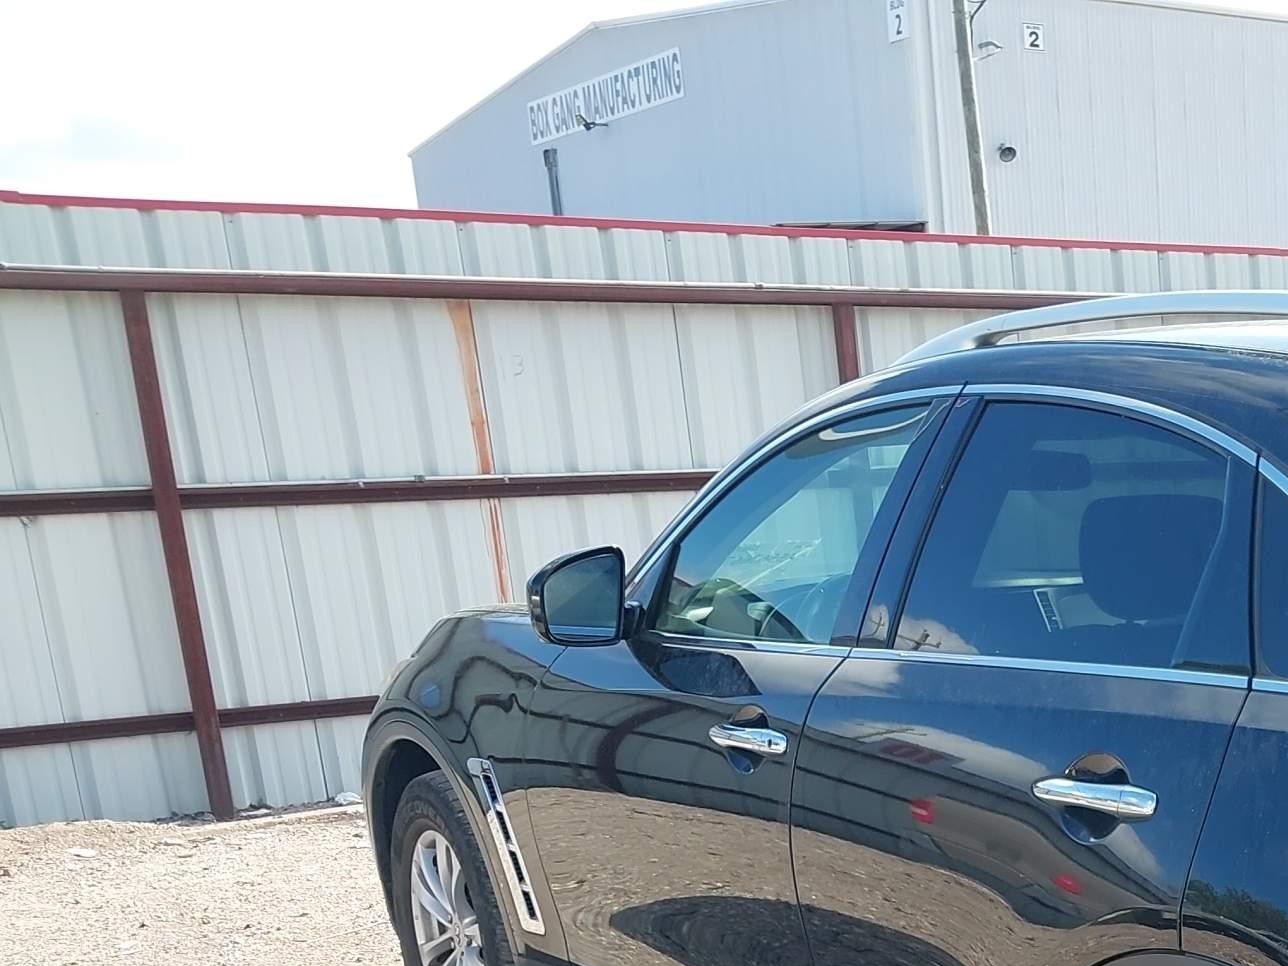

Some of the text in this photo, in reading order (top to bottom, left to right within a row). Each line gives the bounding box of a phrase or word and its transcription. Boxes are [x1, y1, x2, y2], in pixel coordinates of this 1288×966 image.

[895, 14, 903, 36] 2
[1029, 31, 1040, 49] 2
[529, 52, 683, 142] BOX GANG MANUFACTURING
